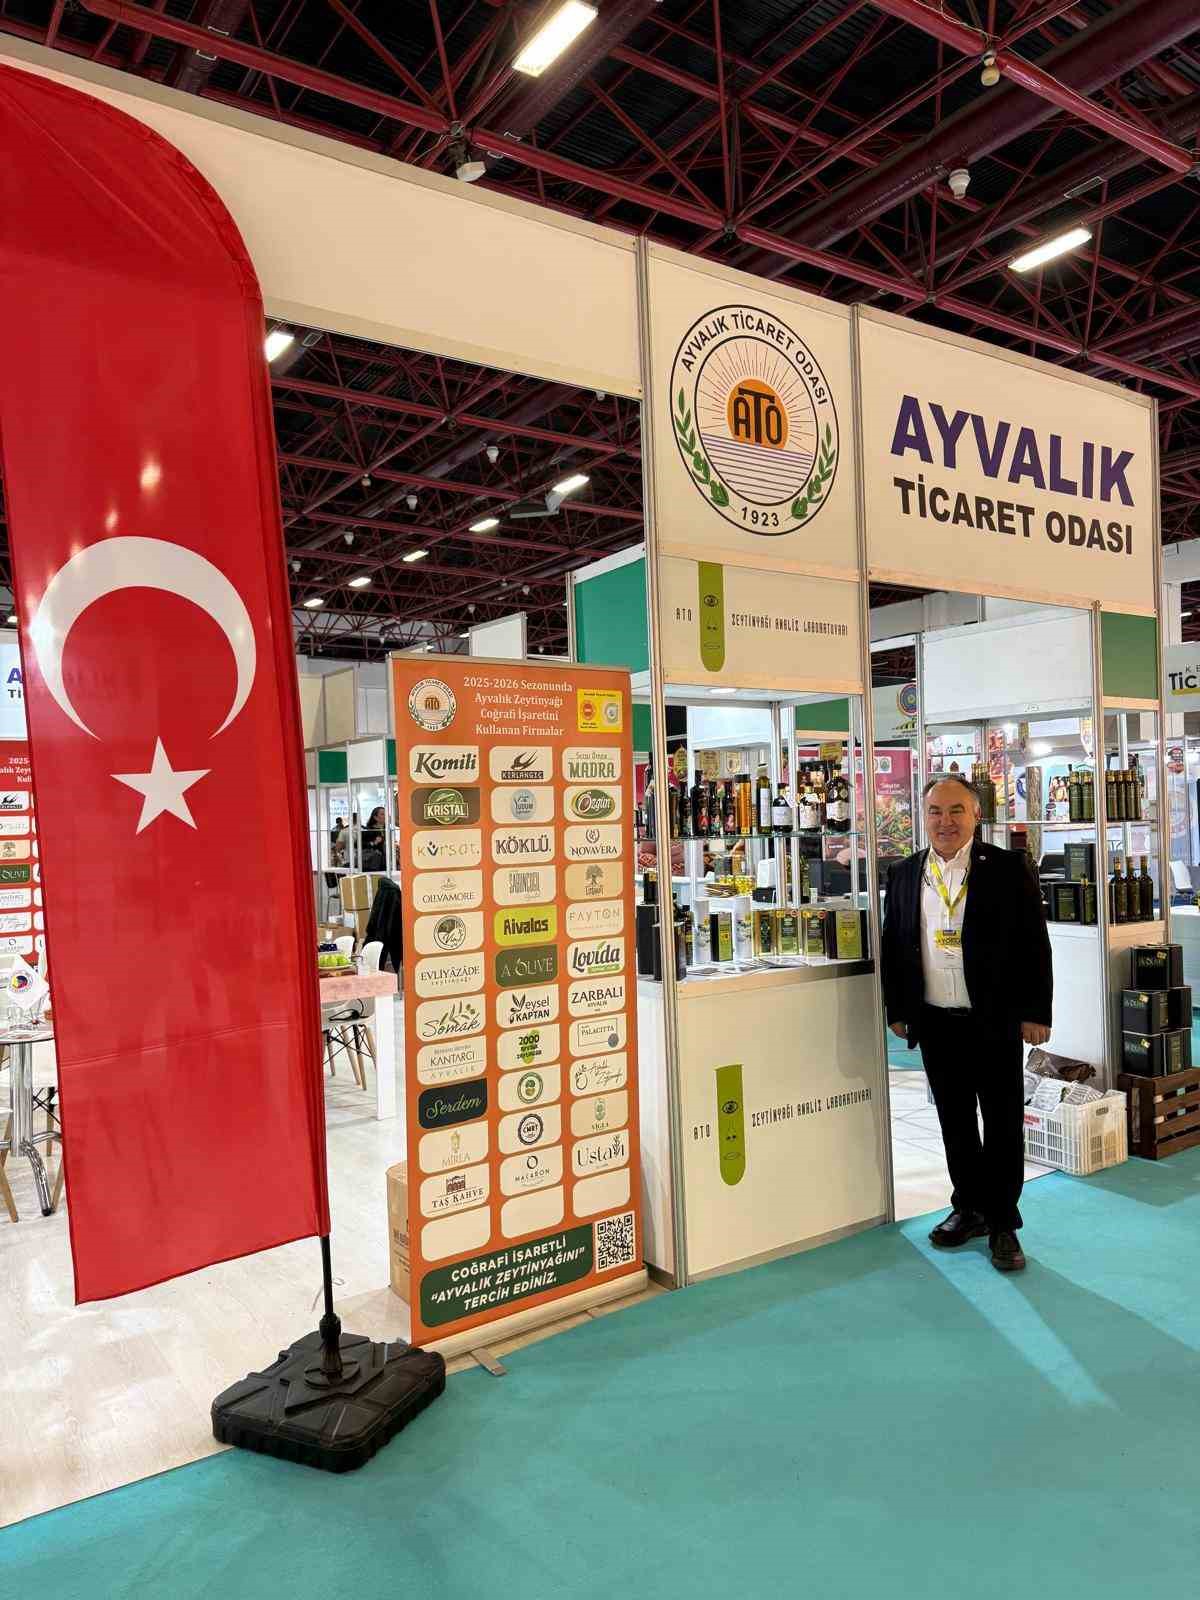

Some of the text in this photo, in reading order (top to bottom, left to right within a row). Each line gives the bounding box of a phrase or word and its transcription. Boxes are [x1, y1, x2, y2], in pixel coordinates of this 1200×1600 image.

[681, 309, 828, 405] AYVALIK TİCARET ODASI
[891, 395, 1135, 507] AYVALIK
[742, 506, 779, 527] 1923
[893, 474, 1132, 555] TİCARET ODASI
[463, 677, 520, 689] 2025-2026
[521, 680, 573, 692] Sezonunda
[475, 692, 563, 708] Ayvalık Zeytinyağı
[475, 724, 564, 736] Kullanan Firmalar
[414, 753, 477, 779] Komili
[567, 761, 616, 778] MADRA
[571, 845, 618, 856] NOVAVERA
[503, 917, 550, 936] Aivalos
[572, 944, 620, 973] Lovida
[571, 986, 623, 1004] ZARBALI
[515, 1009, 551, 1022] KAPTAN
[518, 1034, 541, 1046] 2000
[751, 1105, 794, 1128] ZEYTİNYAĞI
[797, 1099, 822, 1117] ANALİZ
[452, 1188, 484, 1204] KAHVE
[451, 1235, 567, 1282] COĞRAFİ İŞARETLİ
[464, 1271, 557, 1311] TERCİH EDİNİZ.
